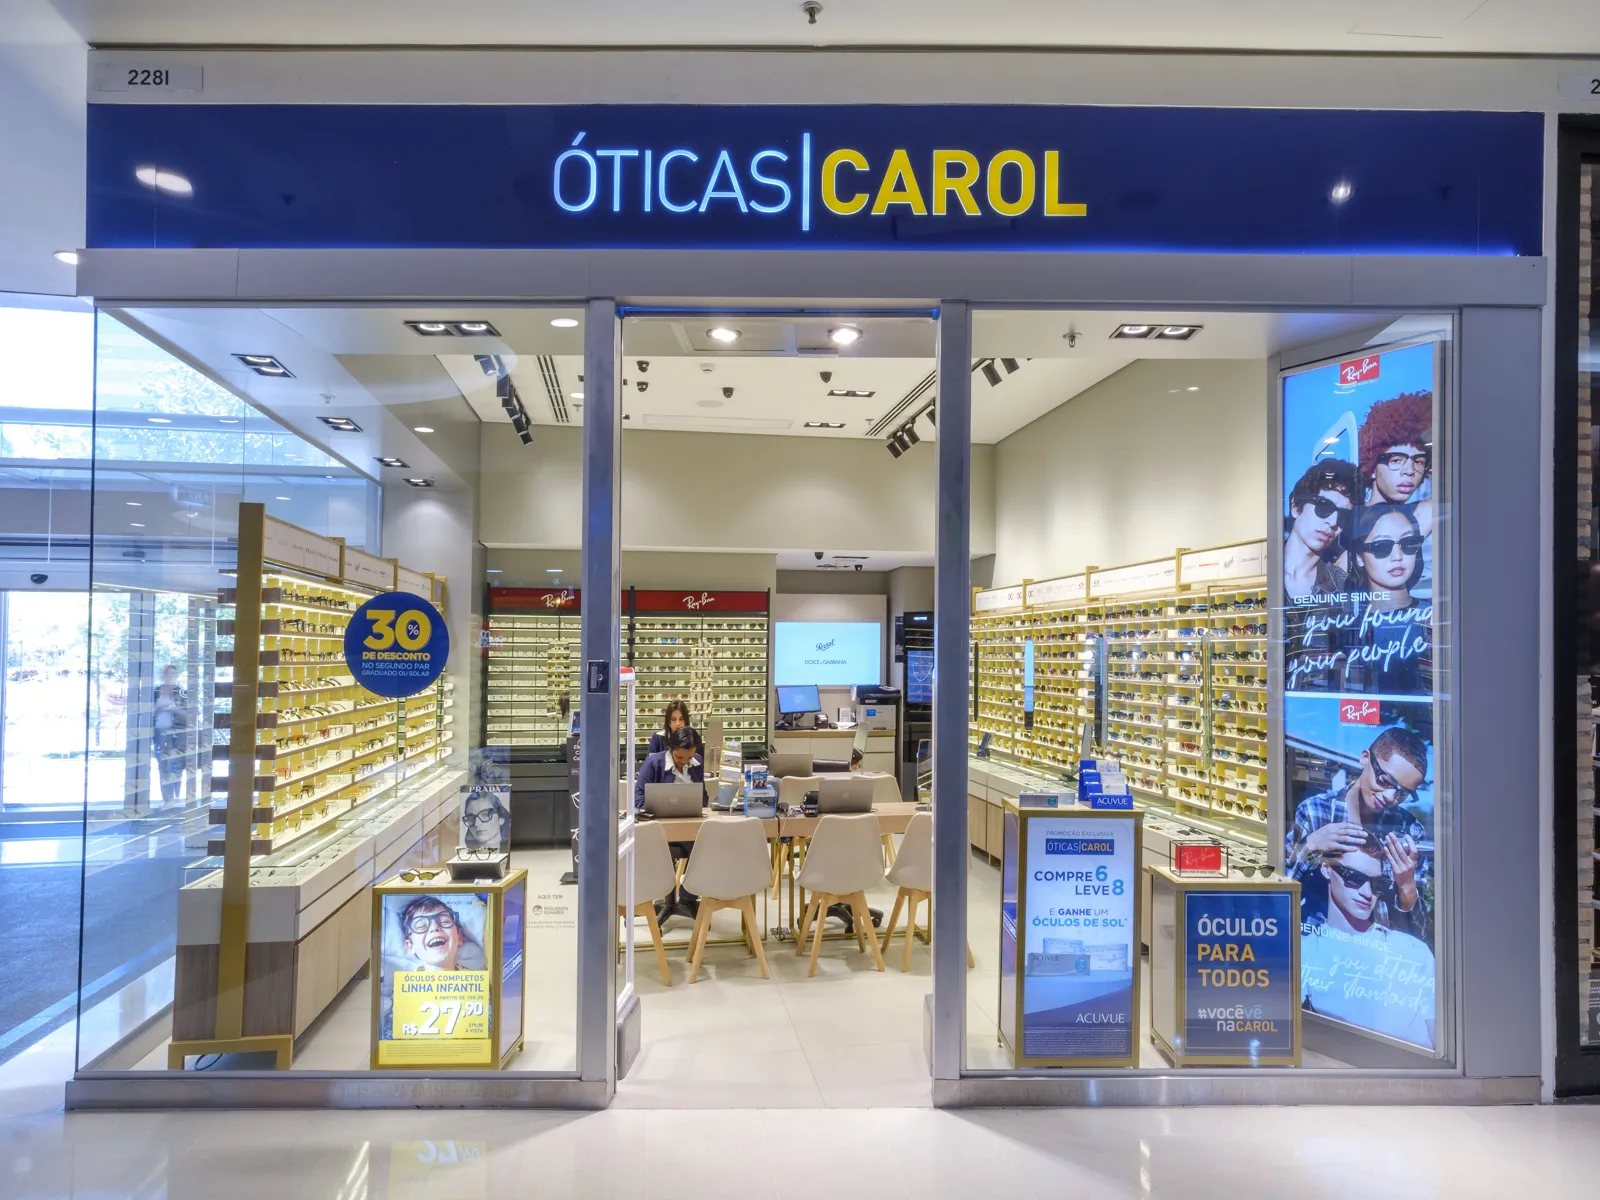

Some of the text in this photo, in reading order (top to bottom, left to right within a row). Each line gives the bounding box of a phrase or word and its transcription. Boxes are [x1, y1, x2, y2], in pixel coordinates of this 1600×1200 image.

[553, 131, 1087, 216] ÓTICAS CAROL
[1342, 358, 1378, 381] Ray-Ban
[682, 592, 715, 610] Ray-Ban
[1294, 591, 1391, 605] GENUINE SINCE
[1302, 615, 1356, 646] you
[362, 651, 431, 661] DE DESCONTO
[1287, 624, 1428, 690] your people
[375, 662, 413, 670] SEGUNDO
[1342, 701, 1378, 721] Ray-Ban
[469, 785, 501, 793] PRADA
[1096, 797, 1128, 805] ACUVUE
[1047, 841, 1113, 852] ÓTICAS CAROL
[1180, 848, 1216, 866] Ray-Ban
[1034, 865, 1108, 882] COMPRE 6
[1075, 879, 1125, 896] LEVE 8
[1058, 908, 1091, 916] GANHE
[1032, 916, 1080, 927] ÓCULOS
[1083, 918, 1099, 927] DE
[1197, 913, 1278, 937] ÓCULOS
[1197, 943, 1256, 962] PARA
[1353, 935, 1392, 953] SINCE
[1329, 954, 1369, 976] you
[404, 974, 485, 983] ÓCULOS COMPLETOS
[1197, 969, 1270, 988] TODOS
[401, 983, 484, 993] LINHA INFANTIL
[1075, 1013, 1125, 1024] ACUVUE
[402, 1023, 419, 1037] R$
